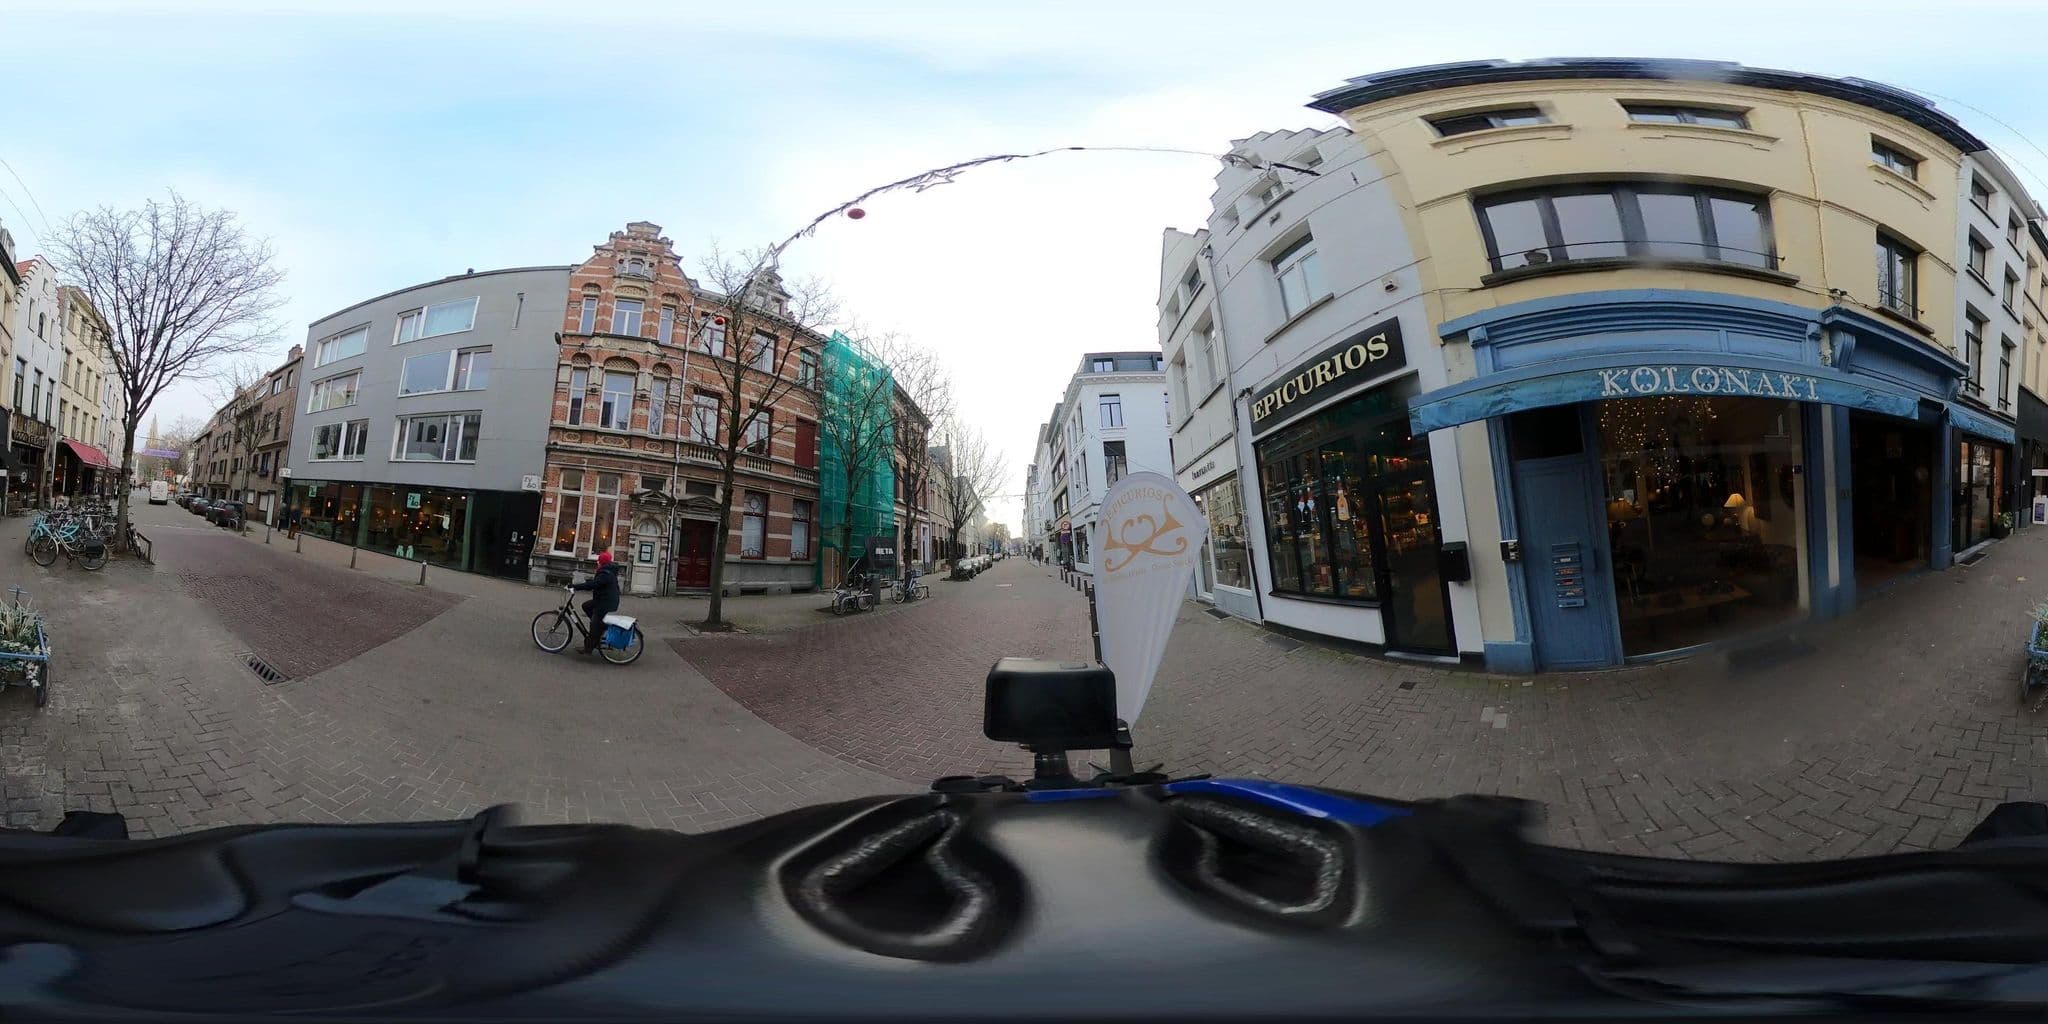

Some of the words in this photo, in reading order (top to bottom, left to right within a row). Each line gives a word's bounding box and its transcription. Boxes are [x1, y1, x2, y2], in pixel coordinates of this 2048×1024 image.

[1252, 332, 1389, 423] EPICURIOS
[1598, 366, 1818, 400] KOLONAKI
[1105, 487, 1163, 520] EPICURIOS
